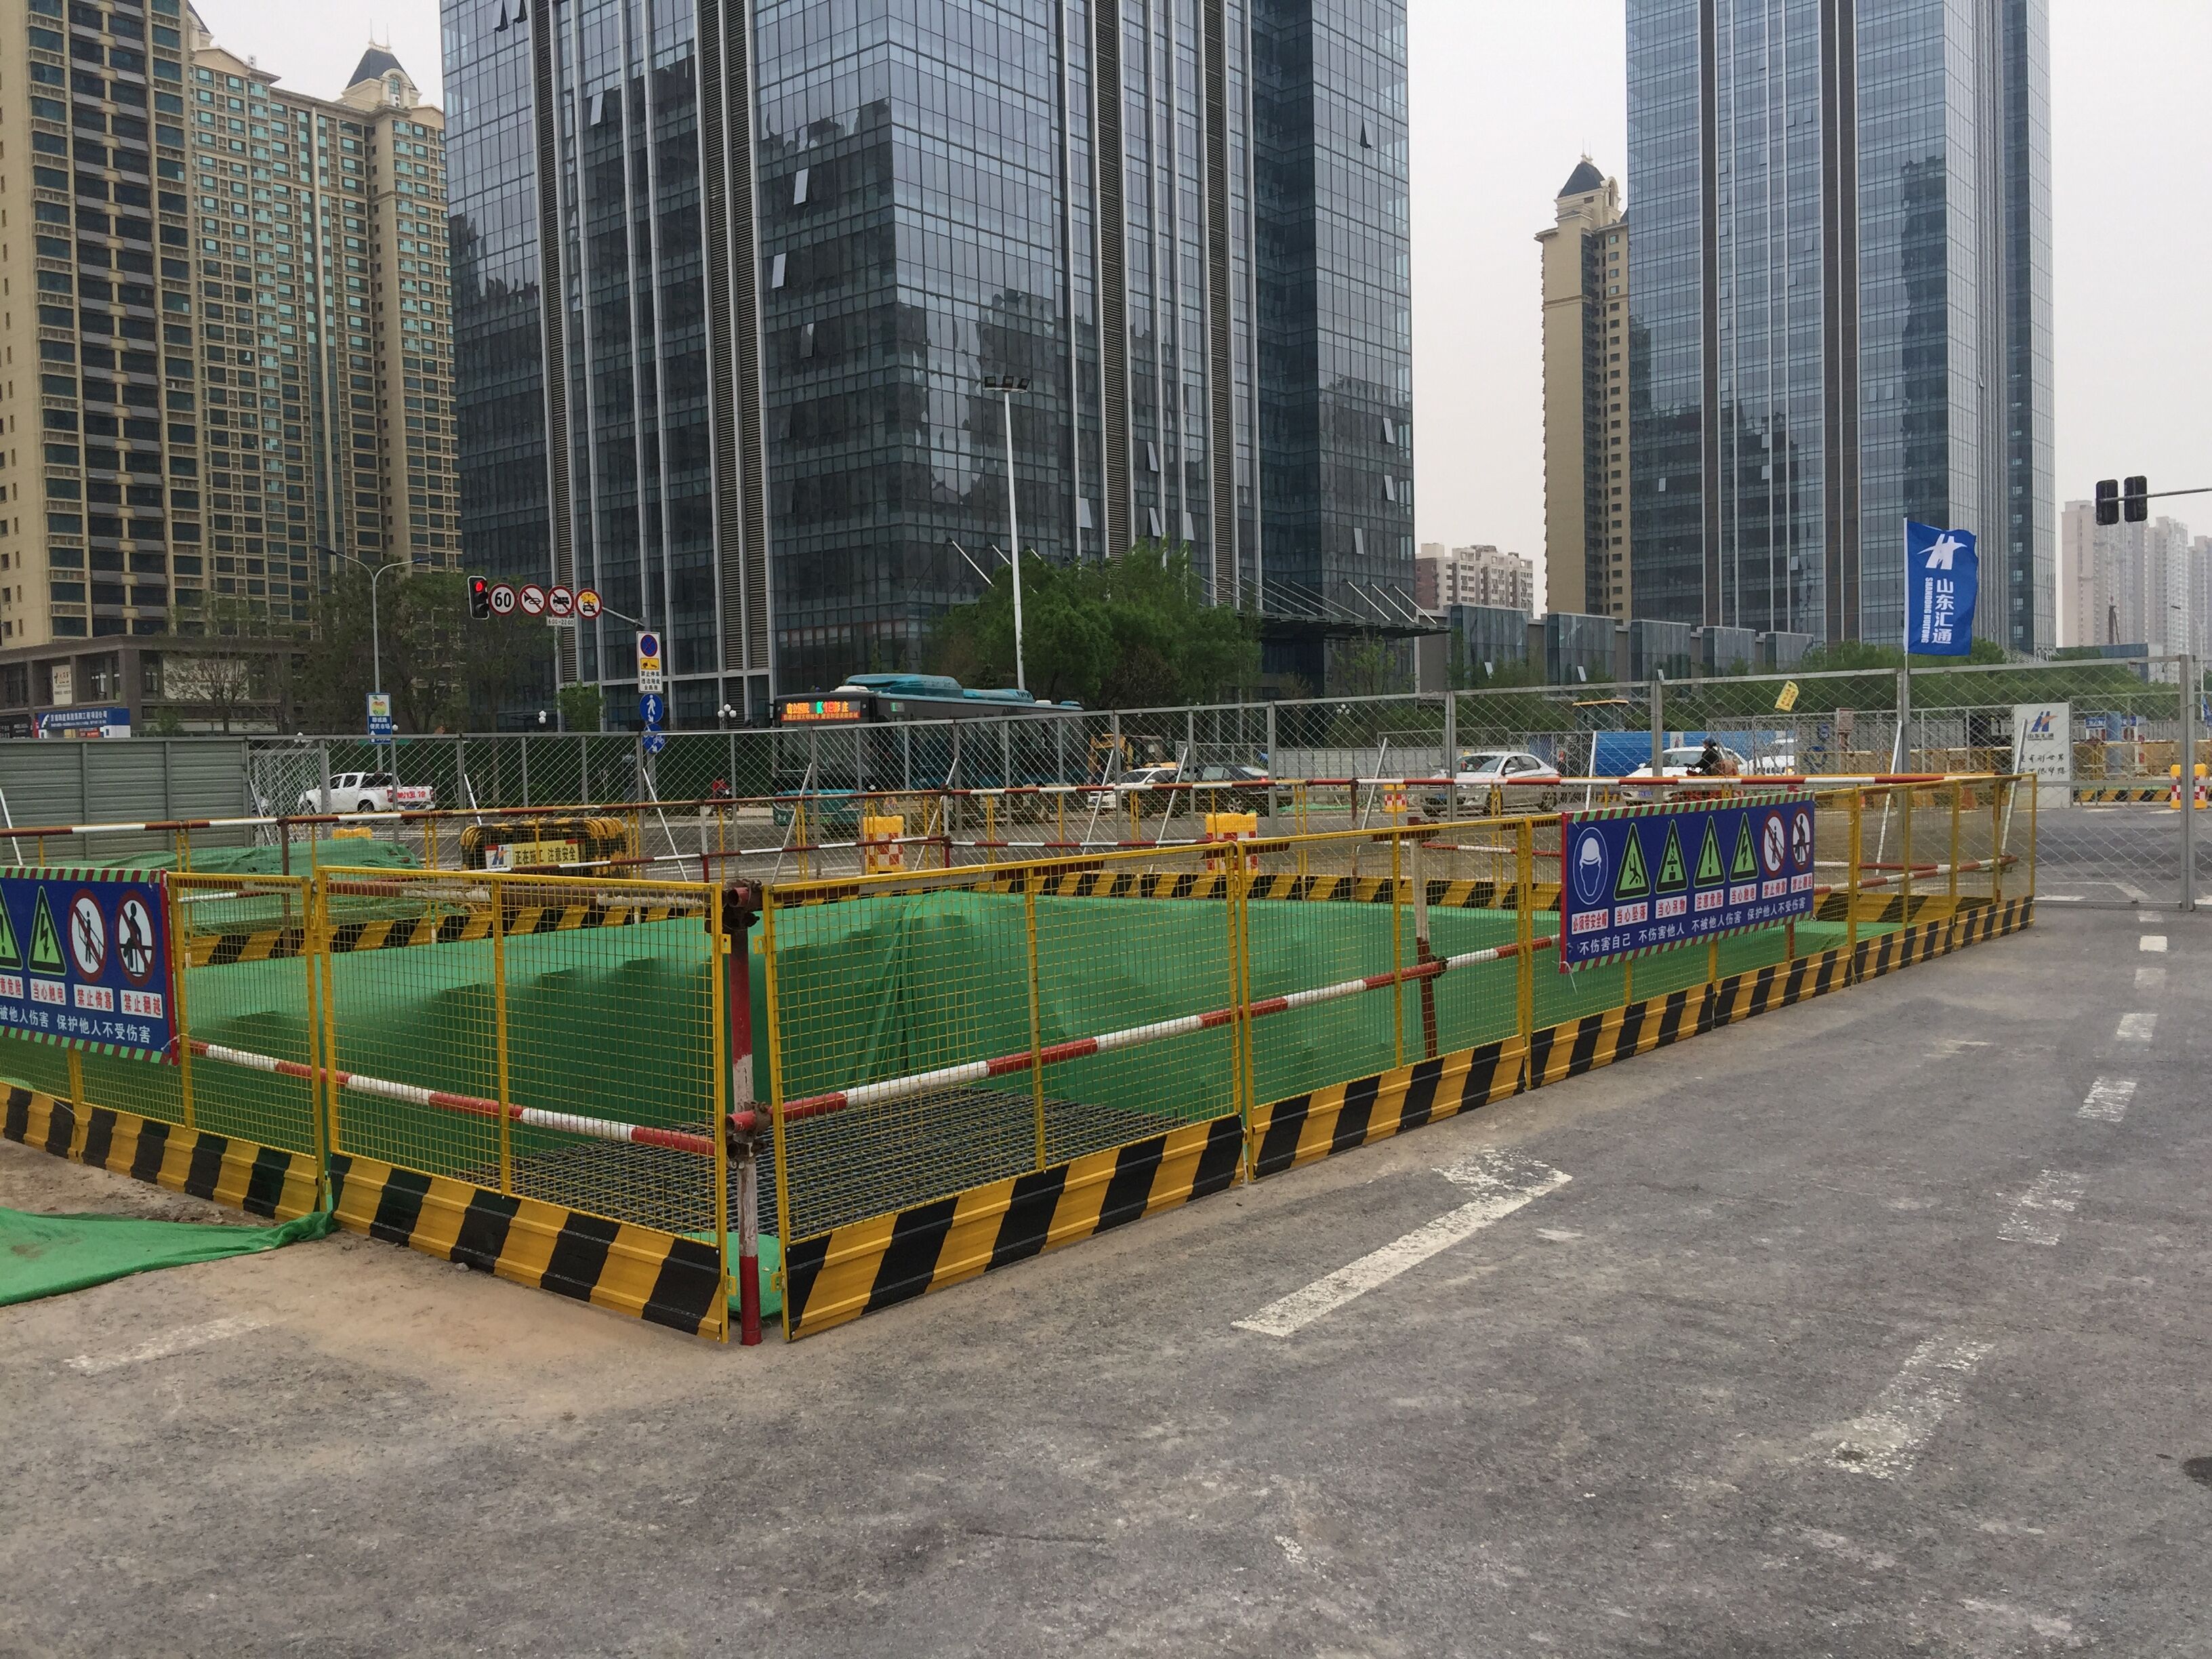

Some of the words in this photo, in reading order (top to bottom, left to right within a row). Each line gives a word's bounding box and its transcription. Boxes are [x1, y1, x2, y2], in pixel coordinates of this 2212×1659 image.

[495, 592, 512, 608] 60
[1924, 577, 1933, 614] SHANDONG
[1931, 578, 1954, 644] 山东汇通
[1921, 614, 1931, 643] HUITONG
[515, 849, 544, 865] 正在施工
[548, 846, 576, 863] 注意安全
[1696, 893, 1723, 909] 注意危险
[1732, 887, 1755, 903] 当心触电
[1616, 905, 1647, 924] 当心坠落
[1658, 899, 1687, 916] 当心吊物
[1580, 933, 1631, 956] 不伤害自己
[1639, 922, 1685, 943] 不伤害他人
[1691, 911, 1742, 933] 不被他人伤害
[1747, 897, 1806, 920] 保护他人不受伤害
[33, 981, 64, 1003] 当心触电
[77, 988, 112, 1010] 禁止倚靠
[124, 993, 161, 1016] 禁止翻越
[0, 1005, 49, 1029] 被他人伤害
[56, 1013, 151, 1044] 保护他人不受伤害
